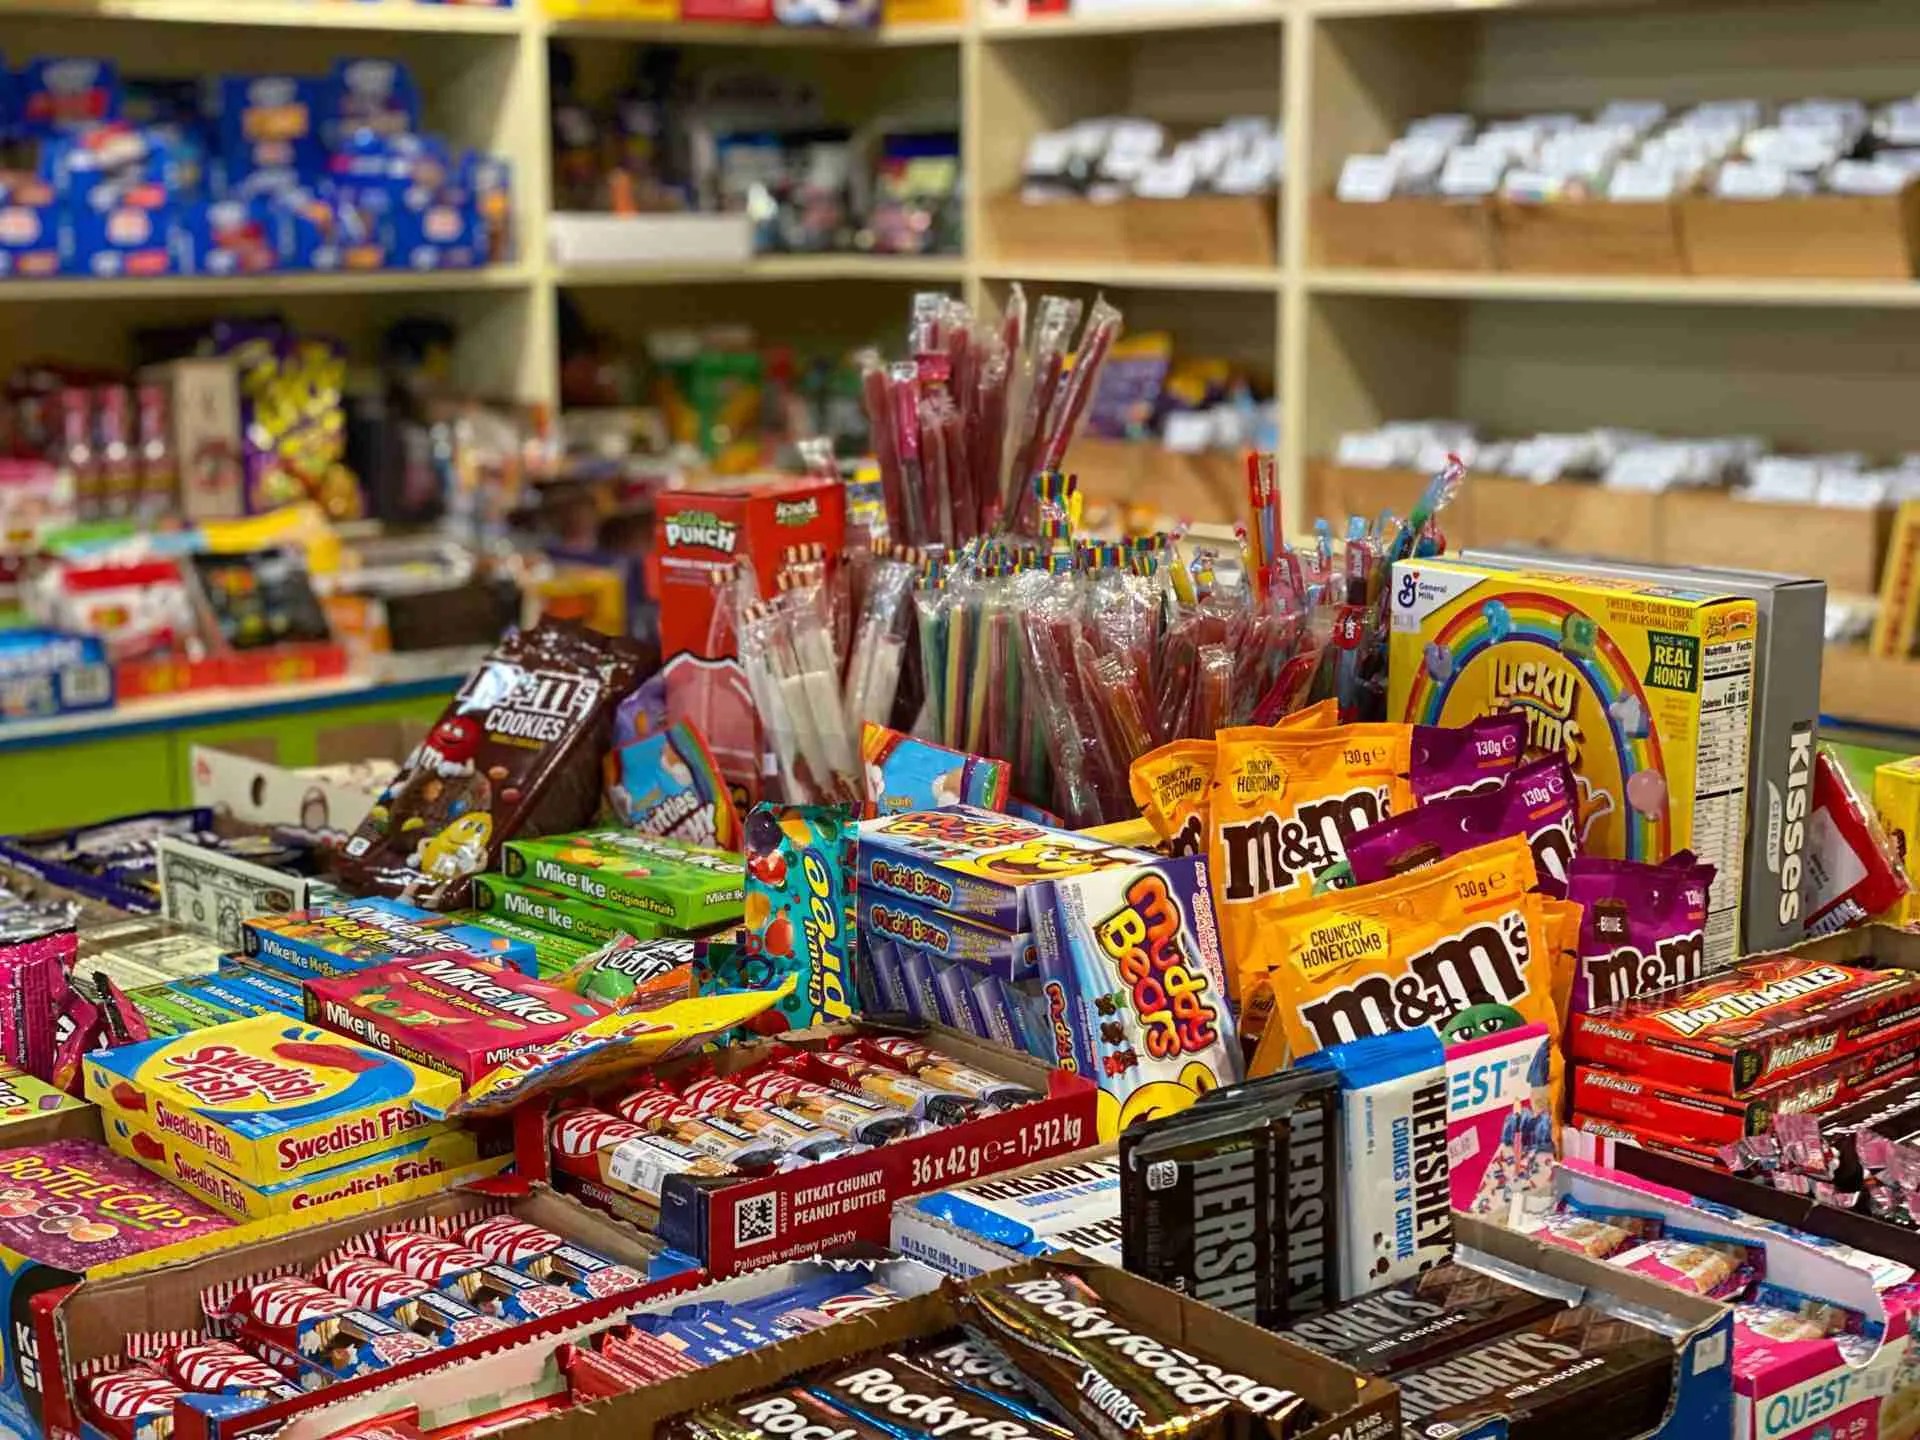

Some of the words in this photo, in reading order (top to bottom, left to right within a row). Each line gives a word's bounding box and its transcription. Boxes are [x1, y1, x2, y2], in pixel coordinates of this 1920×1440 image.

[665, 524, 737, 552] PUNCH
[1419, 582, 1447, 593] General
[1655, 645, 1693, 668] REAL
[1653, 665, 1692, 689] HONEY
[485, 708, 567, 741] COOKIES
[1344, 750, 1362, 765] 130
[536, 860, 577, 890] Mike
[580, 875, 607, 898] Ike
[609, 888, 649, 910] Original
[649, 900, 676, 918] Fruits
[705, 893, 731, 906] Mike
[1455, 880, 1477, 900] 130
[1480, 883, 1488, 897] g
[504, 893, 546, 920] Mike
[548, 907, 573, 929] Ike
[1301, 934, 1382, 969] HONEYCOMB
[1310, 921, 1362, 947] CRUNCHY
[408, 958, 513, 1005] Mike
[507, 990, 570, 1026] Ike
[326, 1000, 364, 1036] Mike
[367, 1021, 391, 1050] Ike
[394, 1039, 426, 1063] Tropical
[428, 1055, 464, 1080] Typhoon
[487, 1048, 524, 1065] Mike
[155, 1066, 257, 1106] Fish
[165, 1045, 326, 1104] Swedish
[155, 1100, 202, 1145] Swedish
[205, 1125, 232, 1161] Fish
[278, 1117, 377, 1170] Swedish
[380, 1104, 430, 1139] Fish
[1392, 1116, 1410, 1183] COOKIES
[912, 1155, 931, 1188] 36
[935, 1159, 944, 1179] x
[946, 1146, 966, 1177] 42
[969, 1147, 979, 1178] g
[1018, 1118, 1062, 1158] 1,512
[1063, 1114, 1082, 1150] kg
[174, 1152, 218, 1196] Swedish
[219, 1181, 248, 1212] Fish
[793, 1183, 835, 1207] KITKAT
[837, 1169, 883, 1193] CHUNKY
[100, 1194, 208, 1230] CAPS
[793, 1200, 841, 1227] PEANUT
[842, 1188, 886, 1213] BUTTER
[734, 1249, 777, 1273] Paluszek
[821, 1229, 858, 1250] pokryty
[1395, 1207, 1414, 1261] CREME
[1367, 1336, 1398, 1355] milk
[1399, 1312, 1467, 1343] chocolate
[1504, 1381, 1539, 1401] milk
[1536, 1356, 1606, 1390] chocolate
[1075, 1369, 1146, 1430] S'MORES
[1765, 1374, 1852, 1435] QUEST
